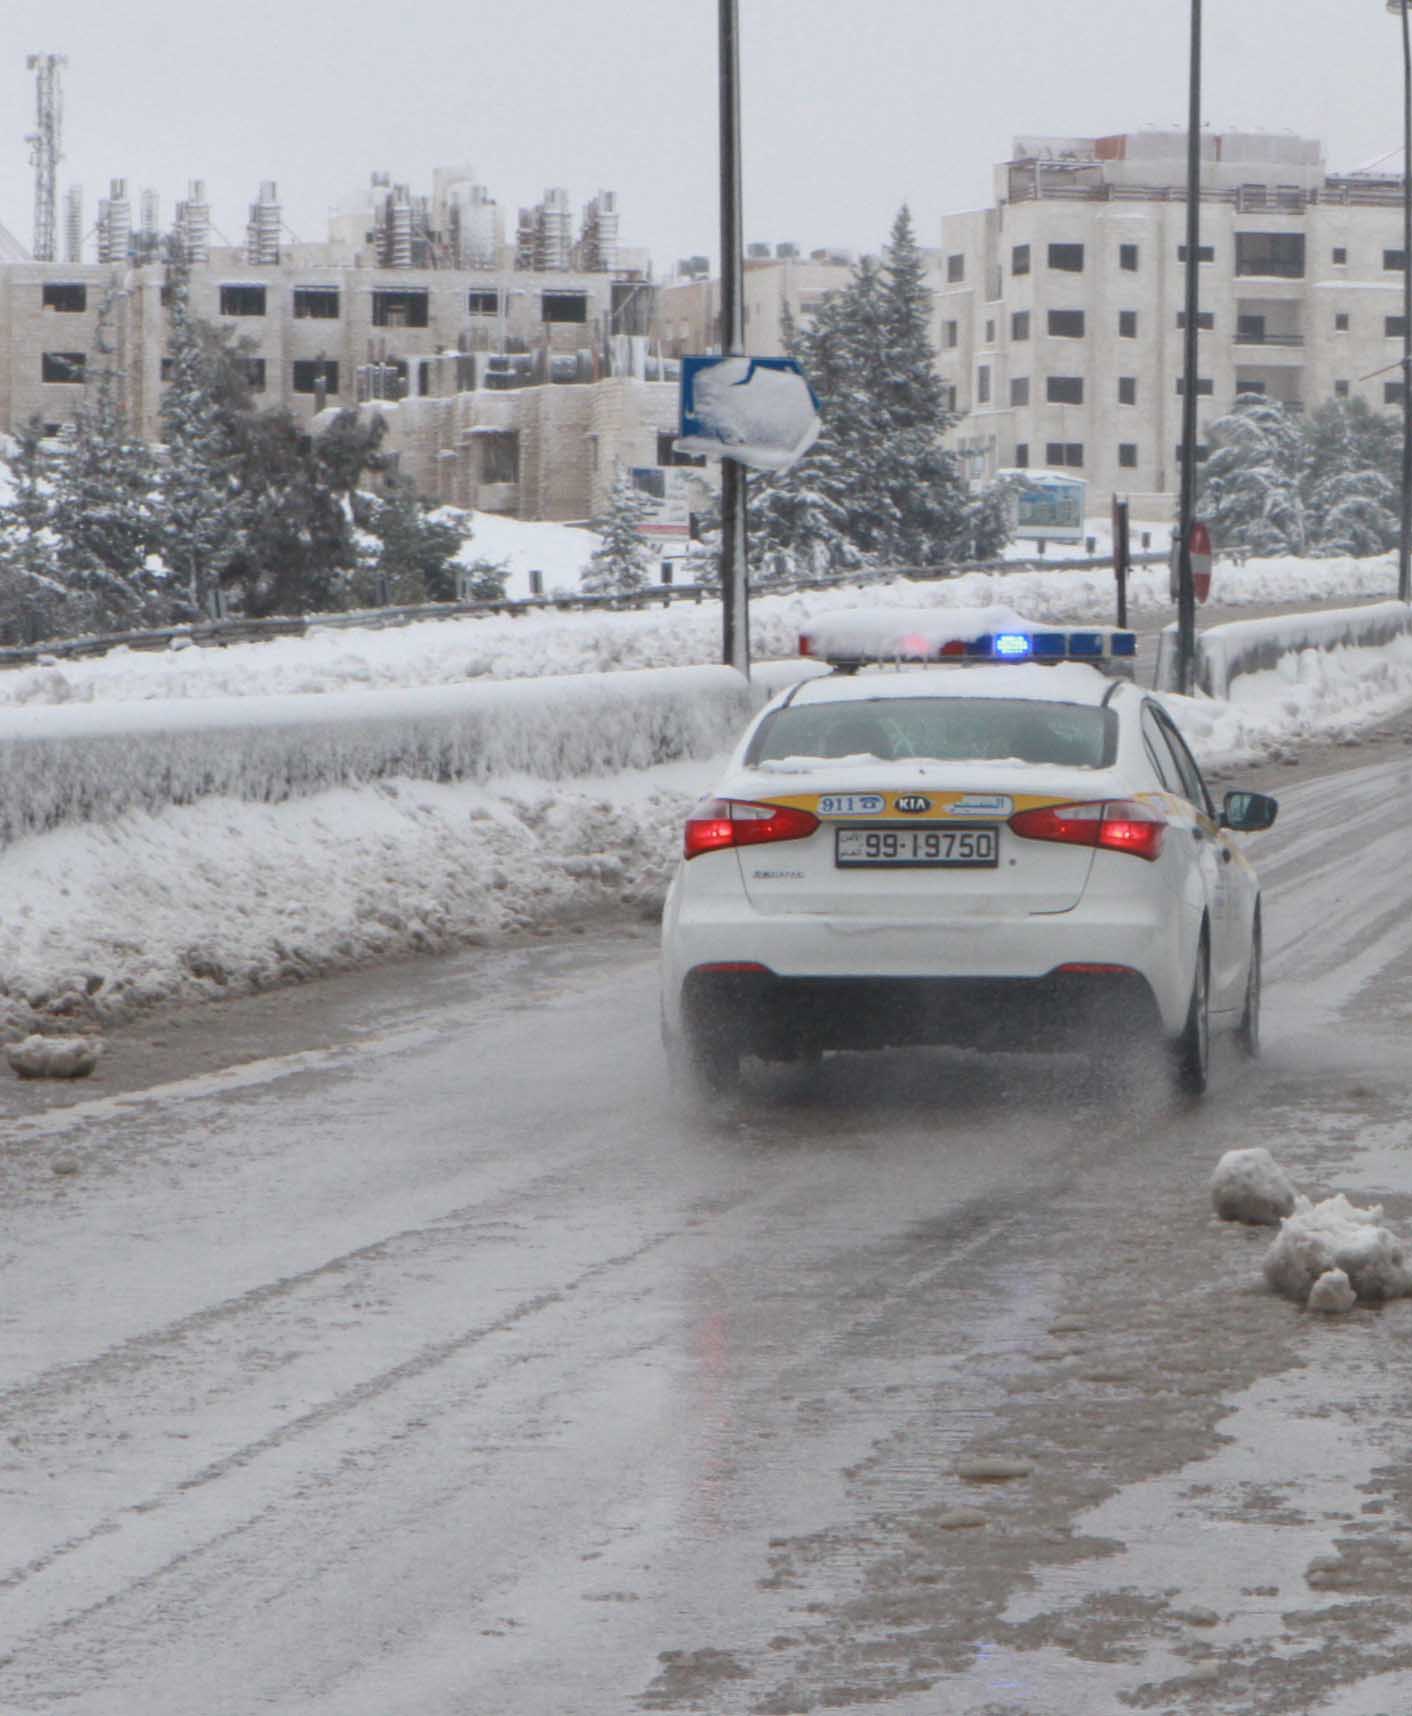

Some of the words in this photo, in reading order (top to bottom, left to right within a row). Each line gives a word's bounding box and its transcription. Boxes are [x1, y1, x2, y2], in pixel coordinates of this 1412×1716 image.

[821, 798, 854, 812] 911
[898, 797, 926, 810] KIA
[866, 833, 992, 858] 99-19750
